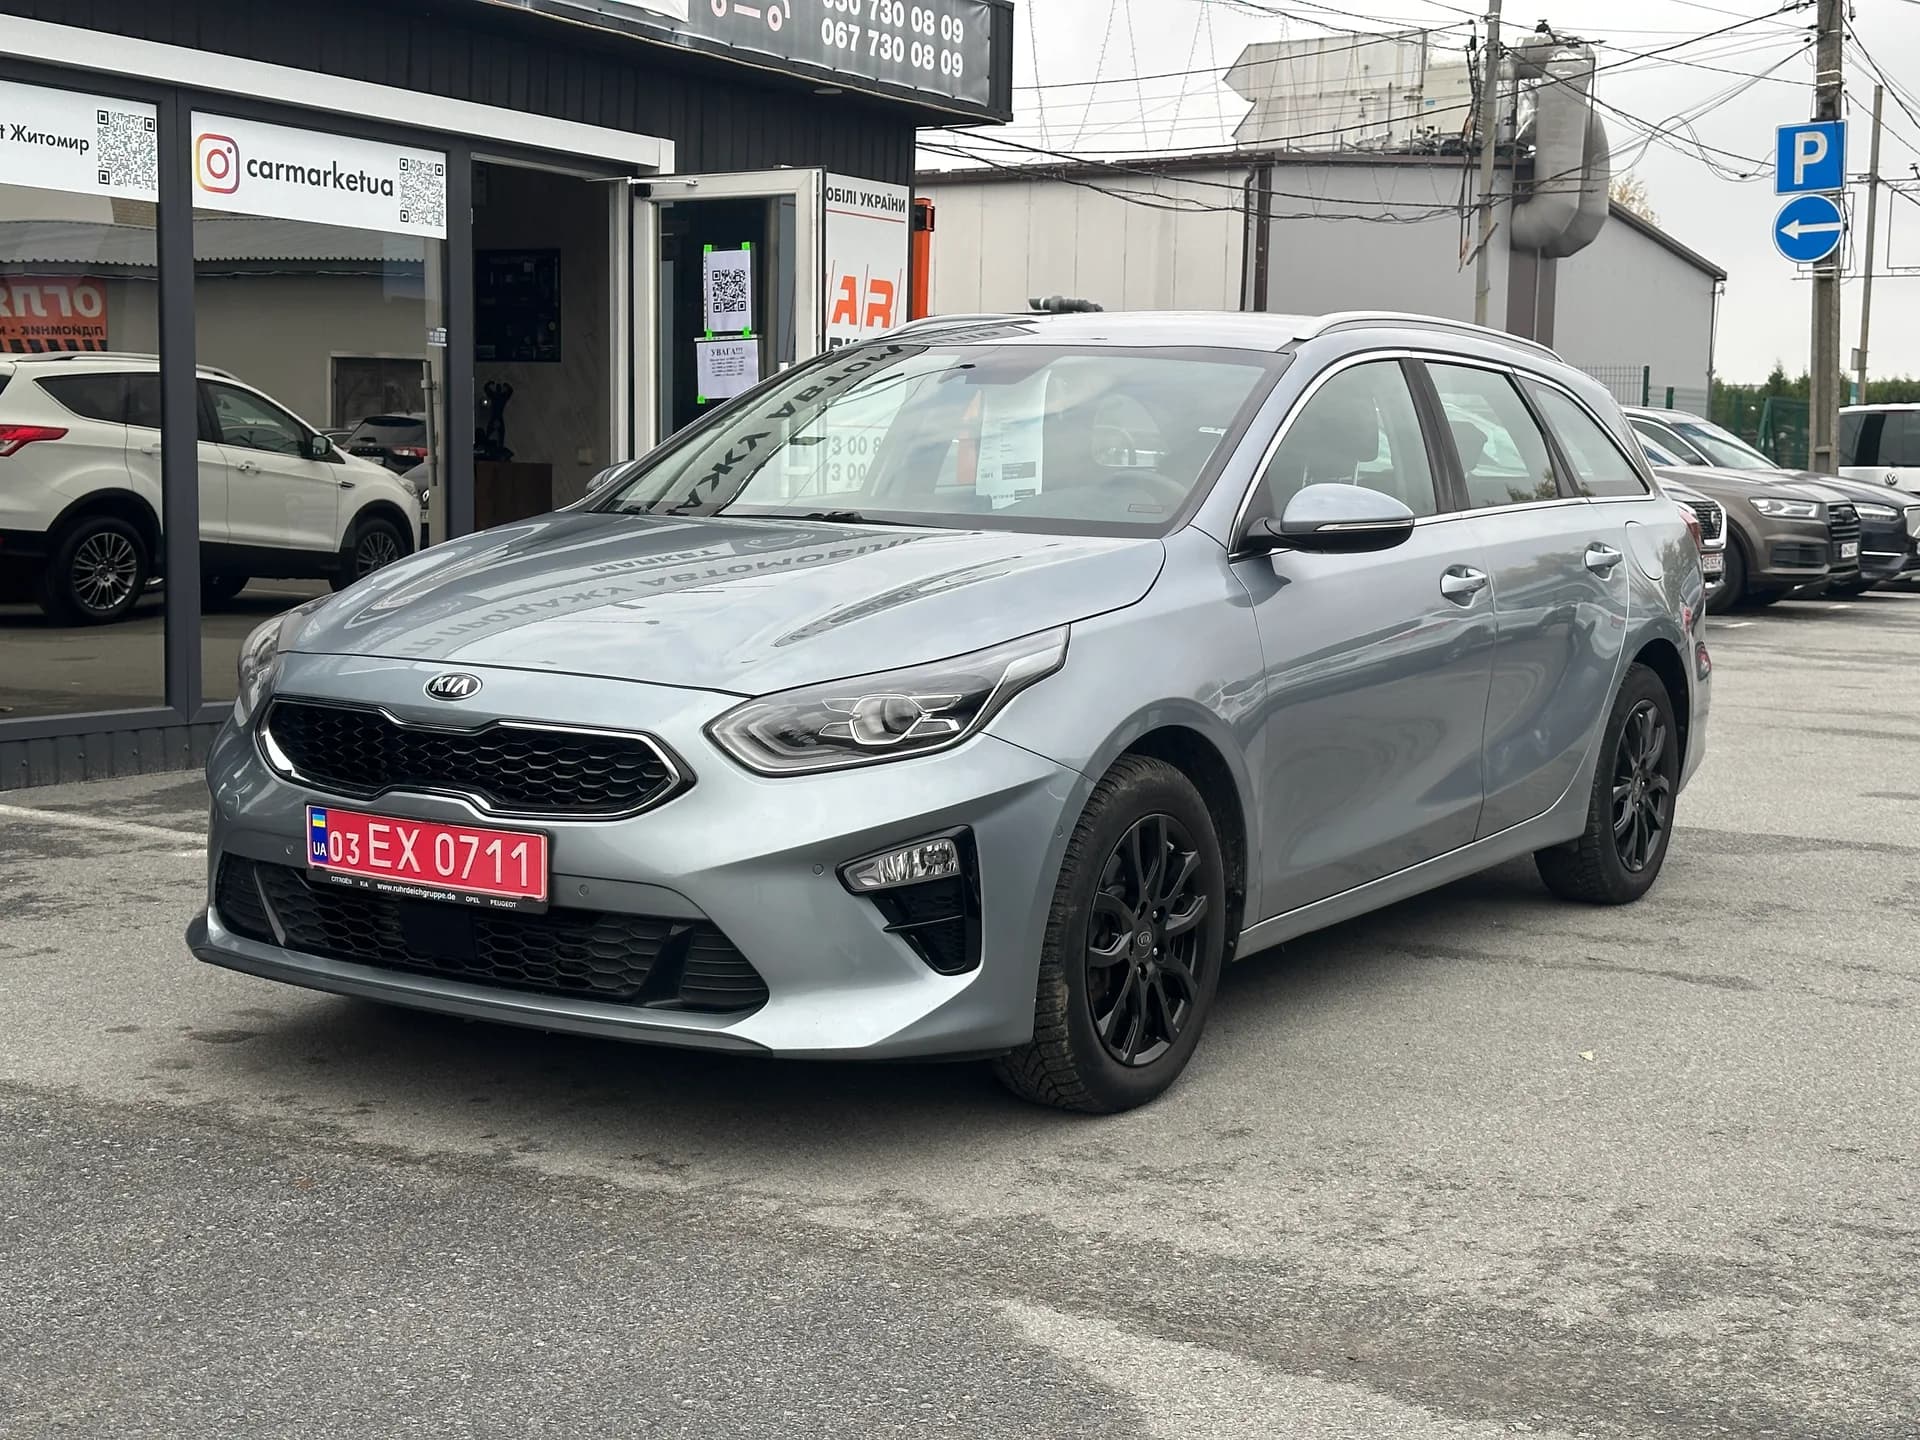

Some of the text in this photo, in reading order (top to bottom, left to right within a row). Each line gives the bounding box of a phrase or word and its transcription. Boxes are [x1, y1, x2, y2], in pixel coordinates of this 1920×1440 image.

[869, 0, 904, 27] 730
[911, 6, 935, 36] 08
[941, 14, 964, 44] 09
[821, 17, 964, 78] 067 730 08 09
[10, 123, 90, 156] Житомир
[1793, 132, 1828, 184] P
[246, 154, 394, 198] carmarketua
[860, 191, 906, 213] УКРАЇНИ
[432, 677, 471, 694] KIA
[313, 842, 327, 857] UA
[329, 822, 529, 887] 03 EX 0711
[465, 896, 480, 904] OPEL
[490, 899, 517, 908] PEUGEOT
